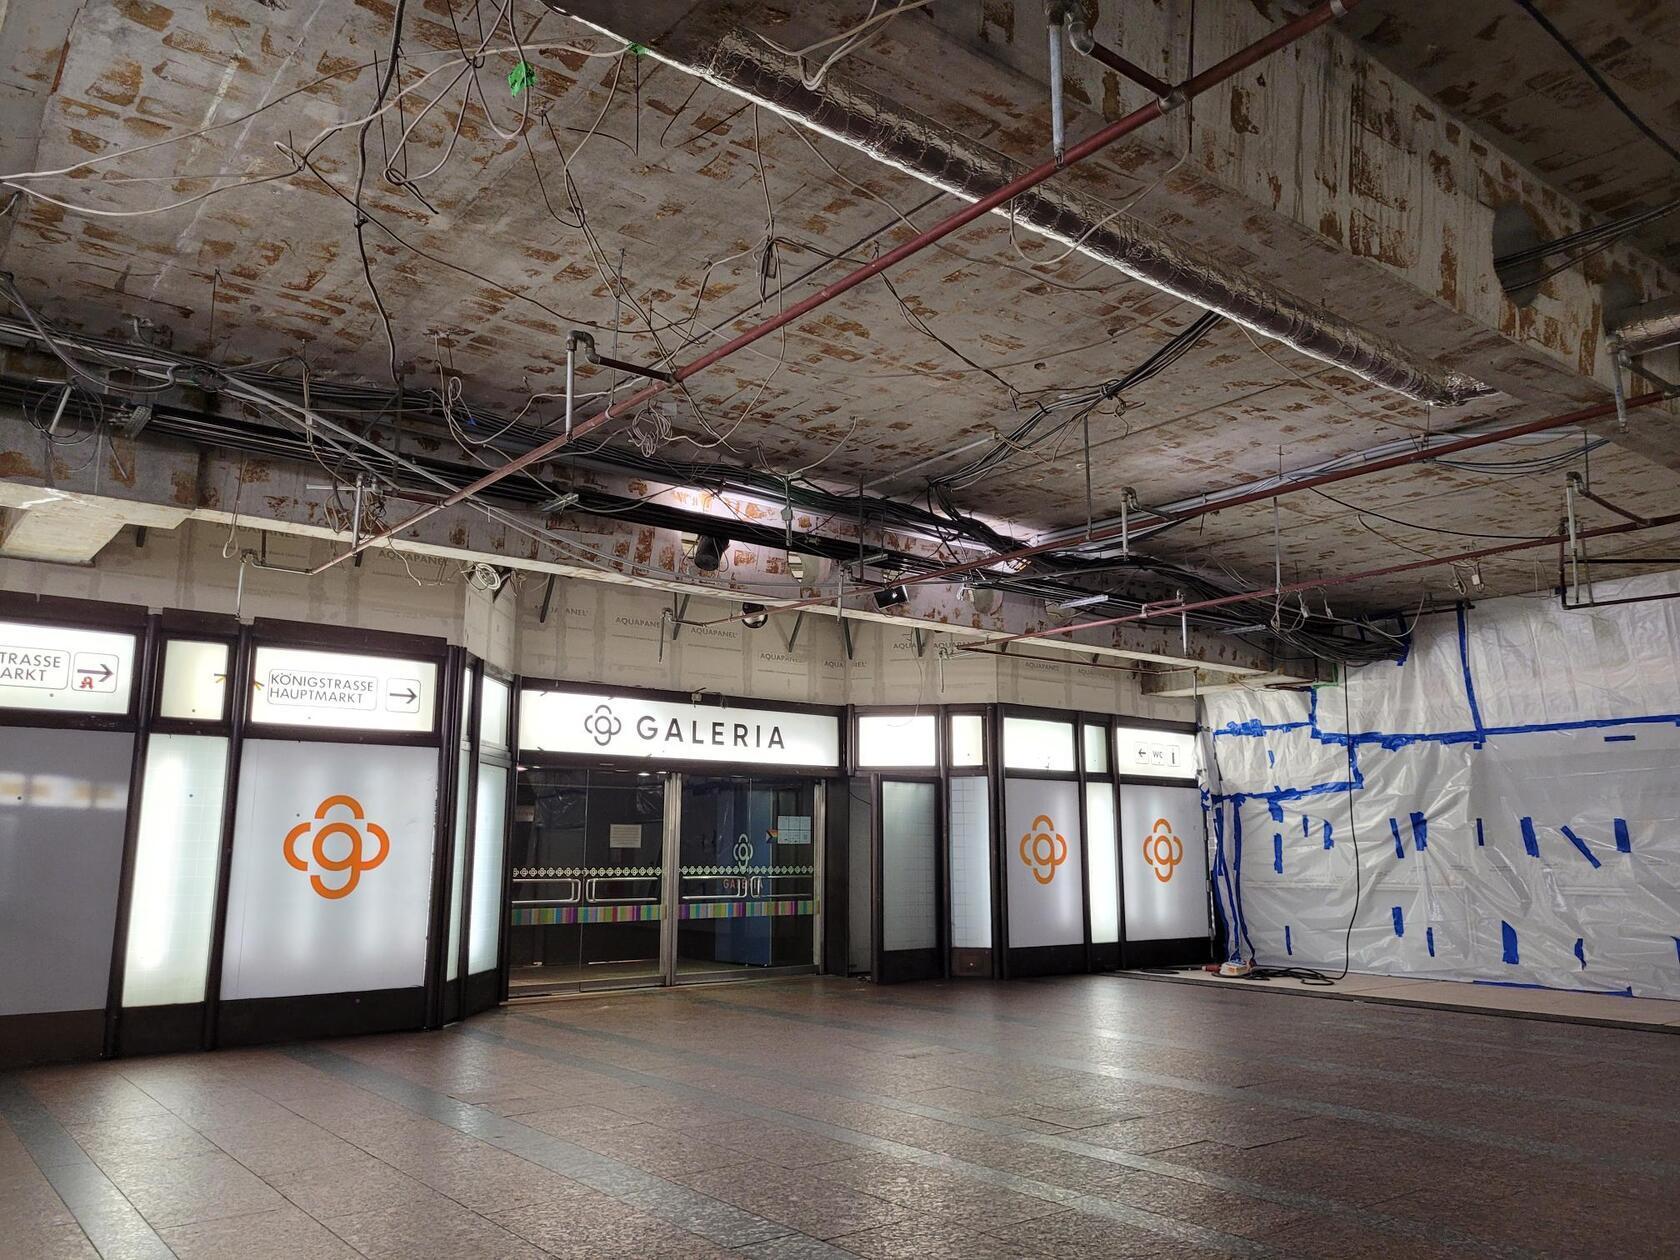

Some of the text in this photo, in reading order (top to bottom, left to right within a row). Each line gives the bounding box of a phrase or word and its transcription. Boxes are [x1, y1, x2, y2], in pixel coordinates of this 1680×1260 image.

[615, 616, 661, 628] AQUAPANE
[0, 651, 61, 668] TRASSE
[0, 667, 47, 681] ARKT
[271, 673, 373, 692] KÖNIGSTRASSE
[269, 688, 363, 703] HAUPTMARKT
[637, 715, 785, 749] GALERIA
